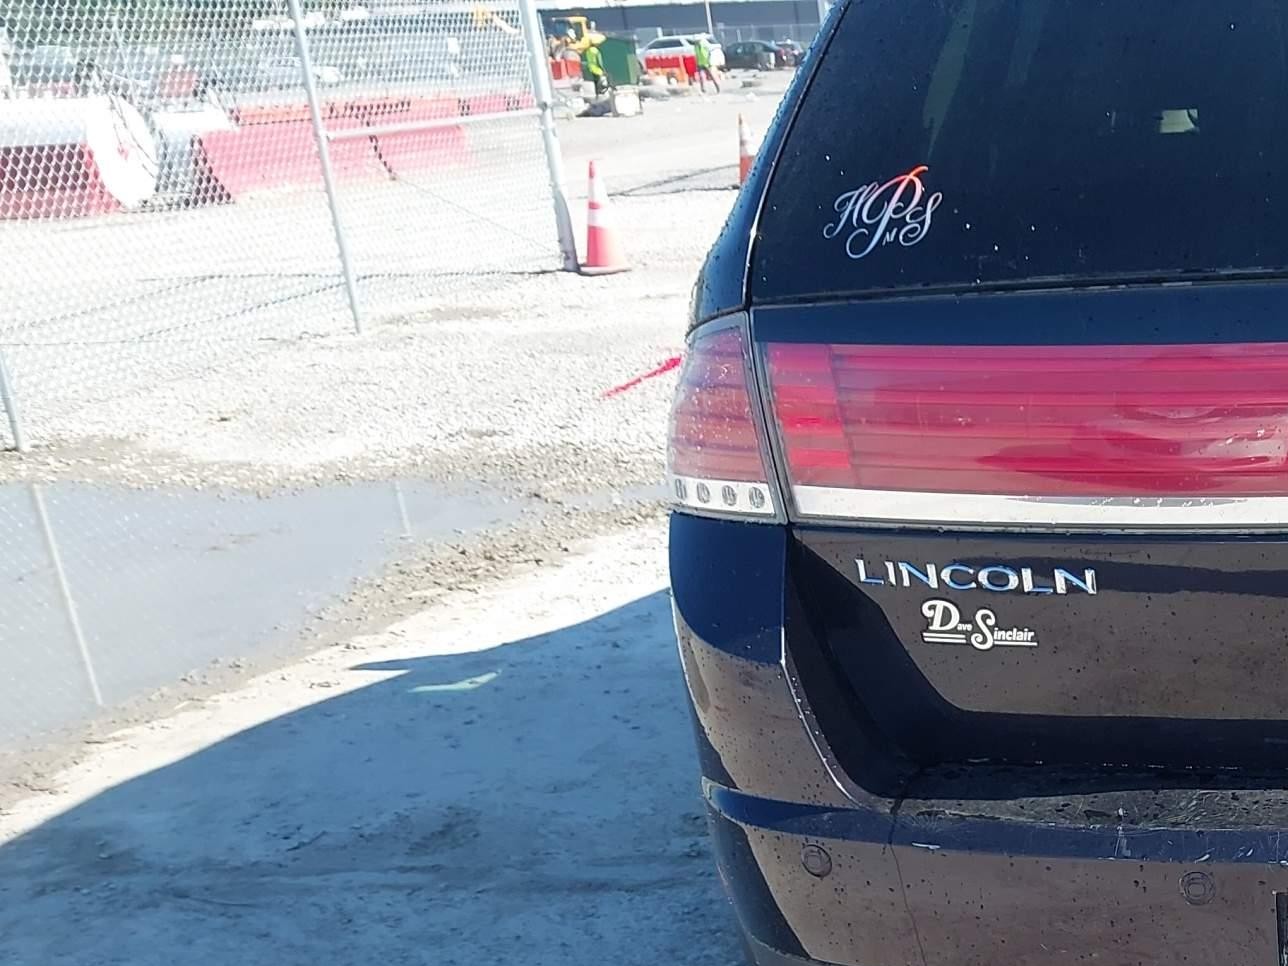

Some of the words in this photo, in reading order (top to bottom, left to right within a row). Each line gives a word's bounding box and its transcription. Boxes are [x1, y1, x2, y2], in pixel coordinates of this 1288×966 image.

[854, 558, 1097, 595] LINCOLN
[921, 599, 973, 632] Dave
[970, 608, 1035, 650] Sinclair
